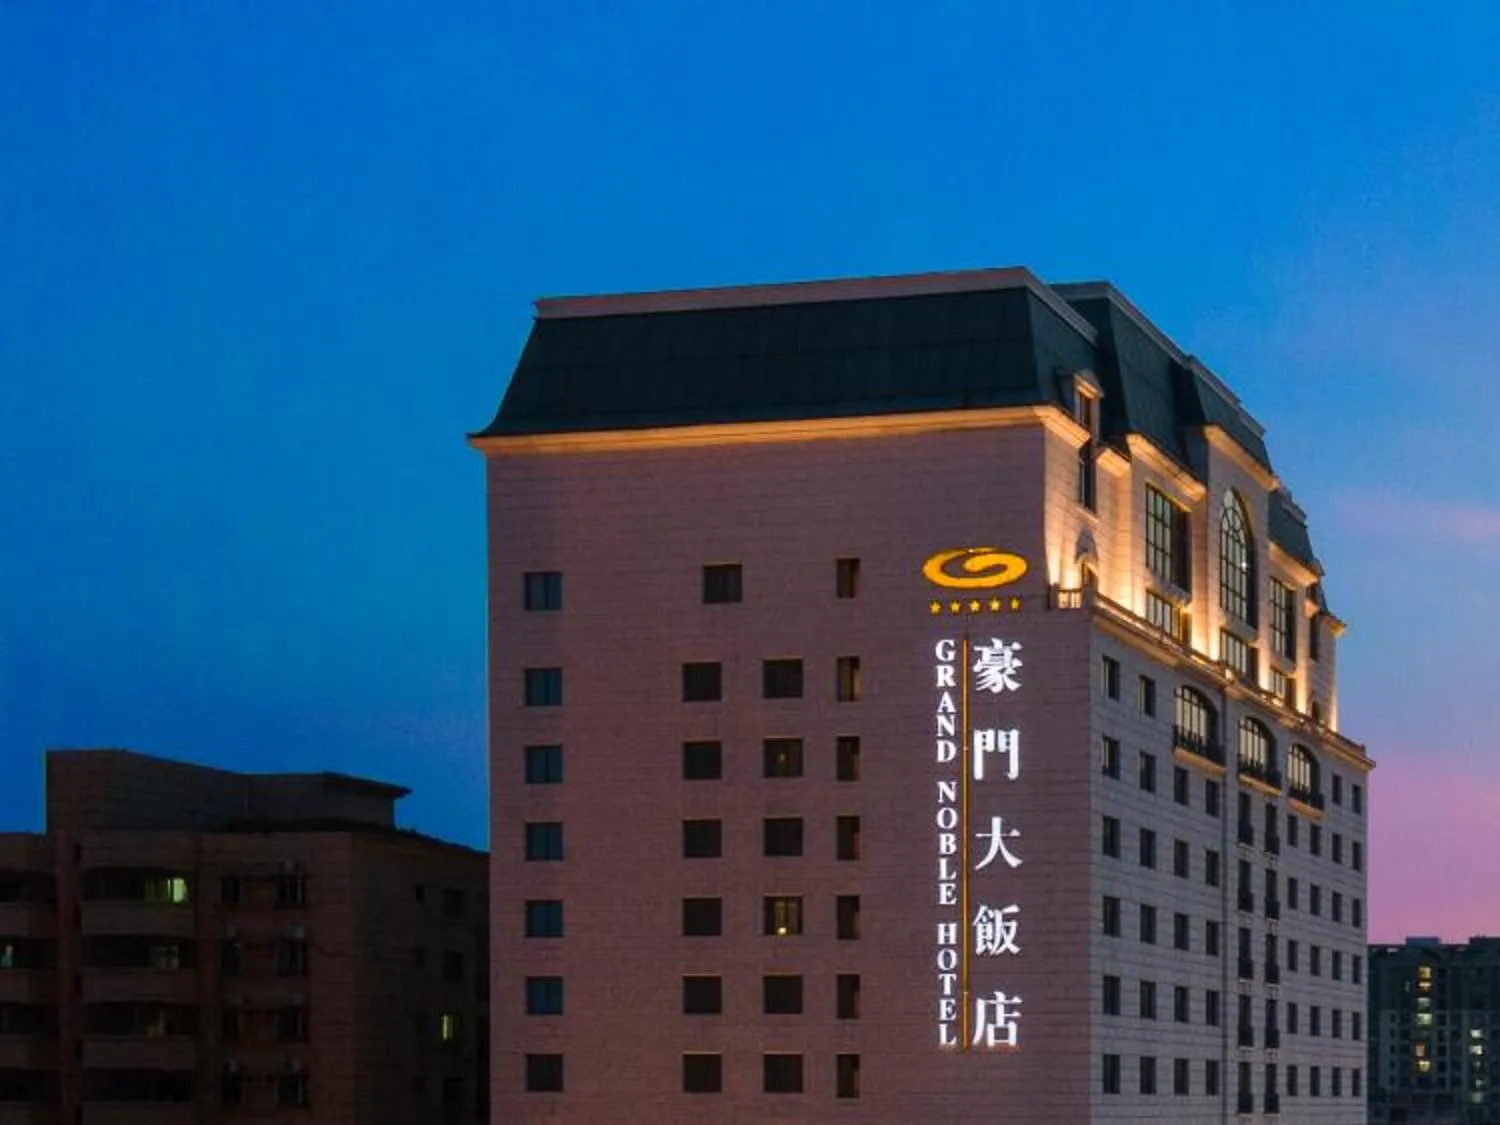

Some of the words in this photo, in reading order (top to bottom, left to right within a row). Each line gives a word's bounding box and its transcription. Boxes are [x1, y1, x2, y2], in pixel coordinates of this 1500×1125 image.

[935, 639, 957, 764] GRAND
[936, 781, 958, 905] NOBLE
[972, 637, 1024, 1048] 豪門大飯店
[936, 922, 958, 1046] HOTEL
